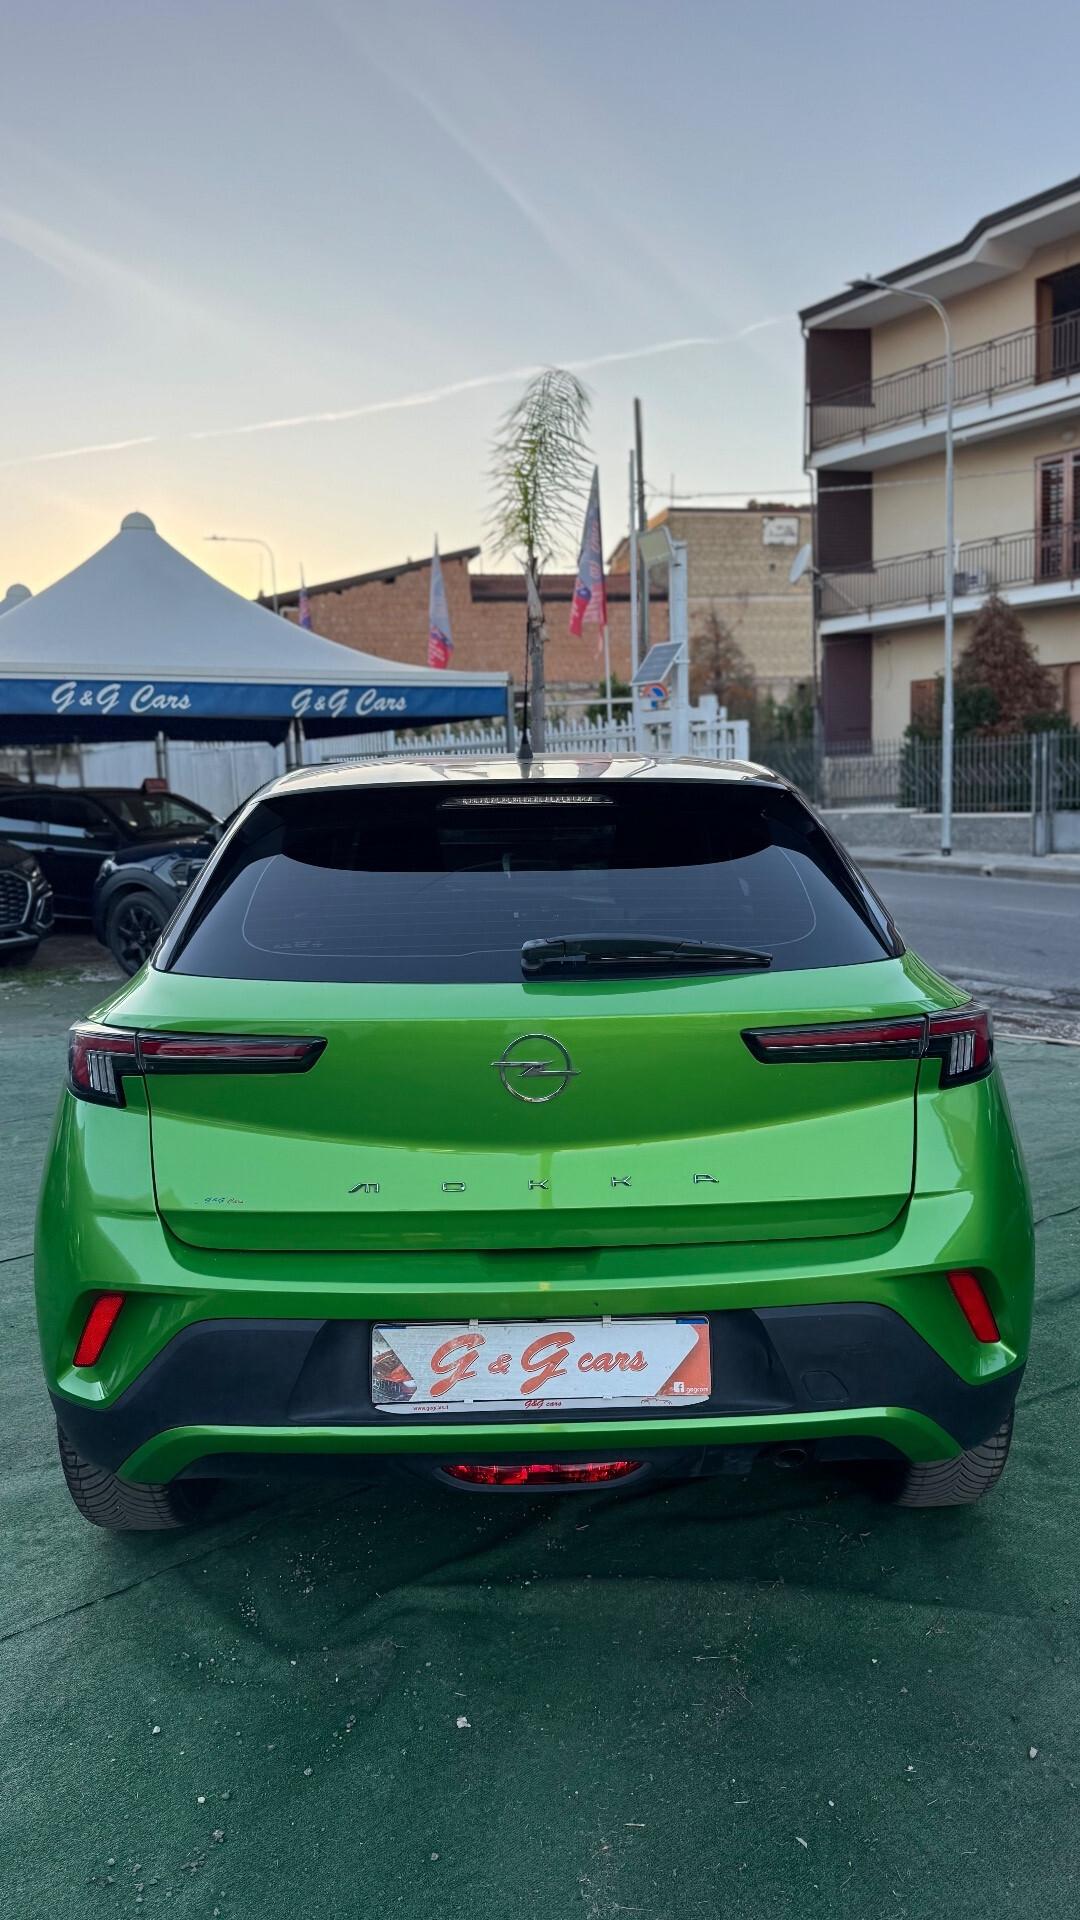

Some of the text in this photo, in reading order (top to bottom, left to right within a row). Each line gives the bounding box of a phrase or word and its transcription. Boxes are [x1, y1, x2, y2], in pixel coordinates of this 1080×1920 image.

[130, 684, 192, 714] Cars
[355, 688, 407, 716] Cars
[577, 1348, 649, 1373] cars
